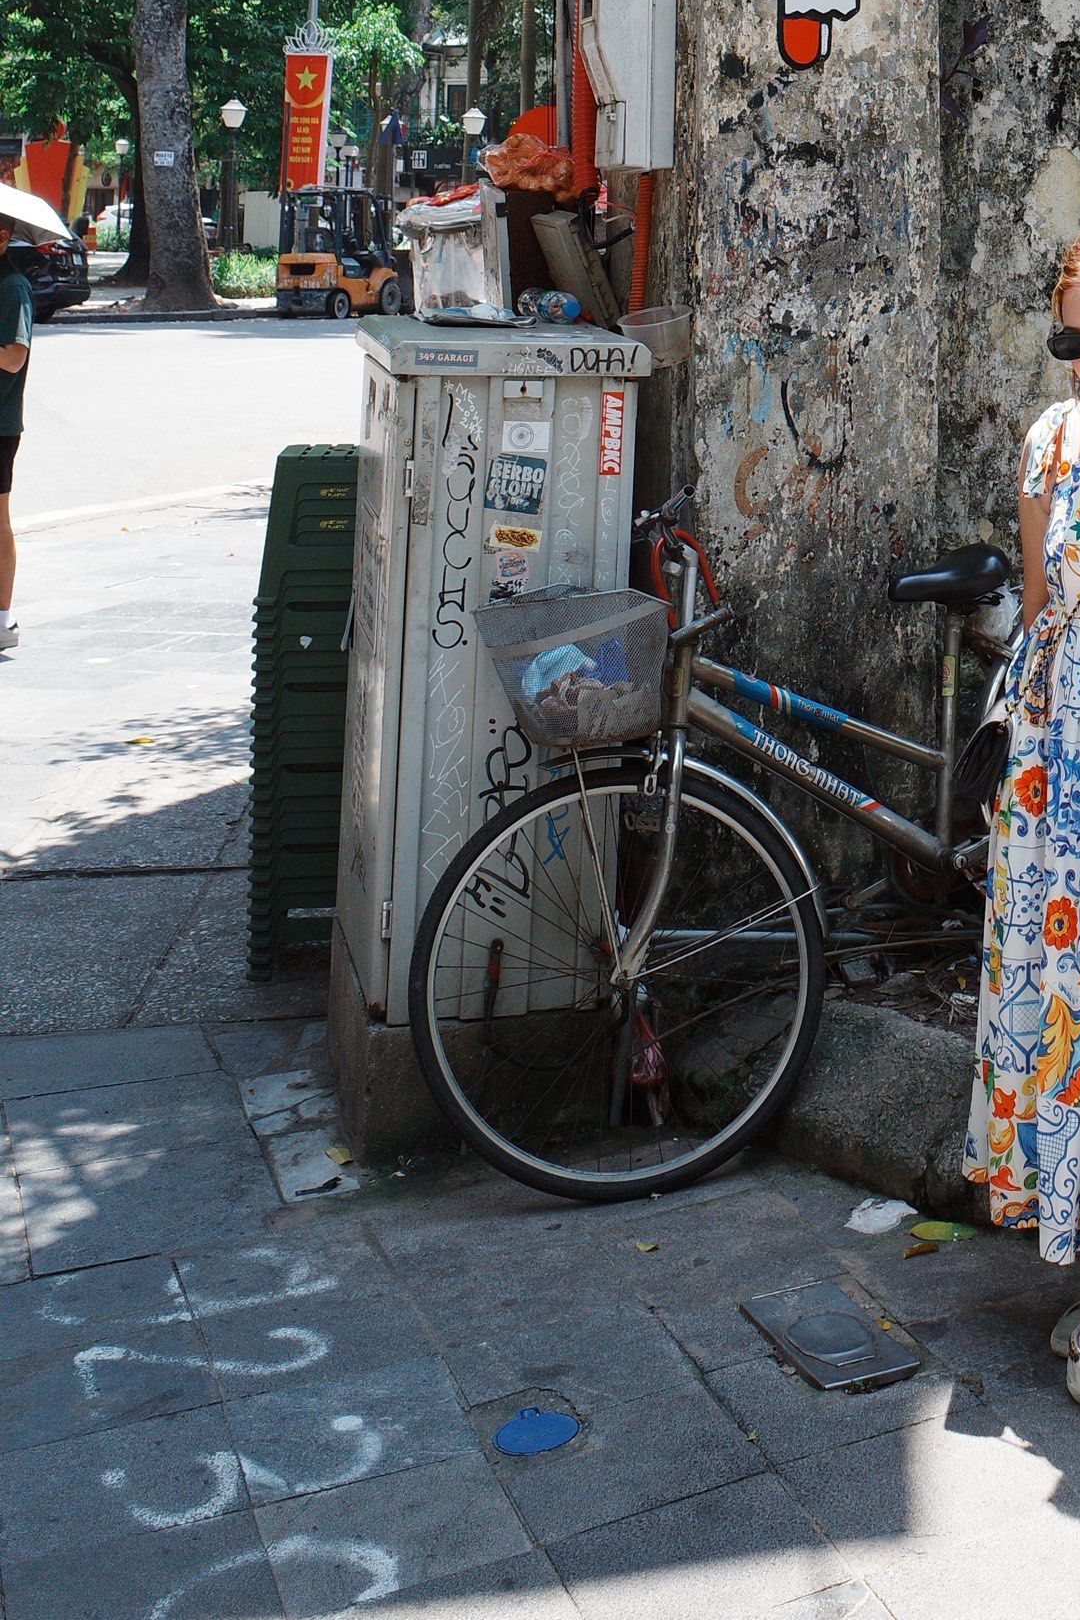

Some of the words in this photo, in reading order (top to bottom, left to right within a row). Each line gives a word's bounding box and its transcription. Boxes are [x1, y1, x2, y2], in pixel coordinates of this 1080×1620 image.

[418, 352, 434, 361] 349
[437, 353, 475, 363] GARAGE
[602, 394, 624, 474] AMPBKC
